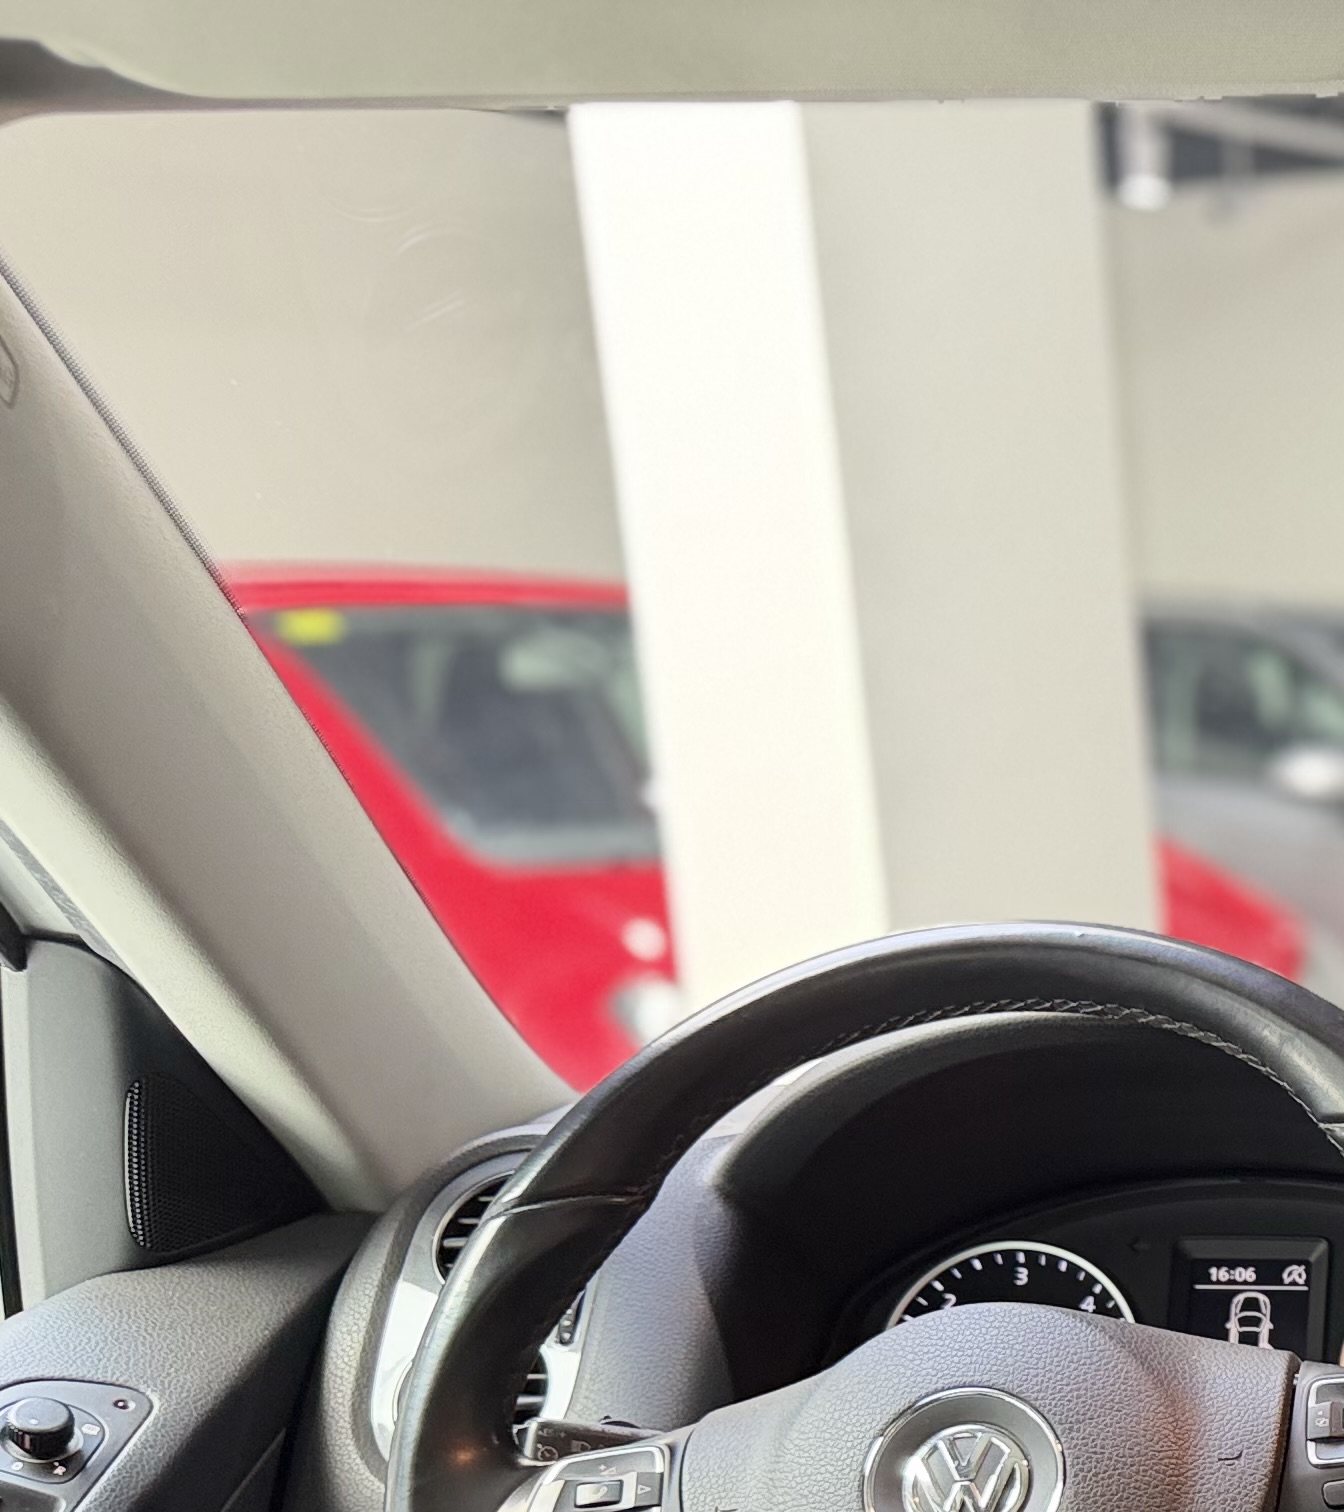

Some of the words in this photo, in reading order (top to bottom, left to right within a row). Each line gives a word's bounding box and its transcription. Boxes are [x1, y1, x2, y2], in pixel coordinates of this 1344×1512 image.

[1013, 1266, 1029, 1286] 3
[1208, 1266, 1257, 1282] 16:06
[1078, 1296, 1096, 1312] 4
